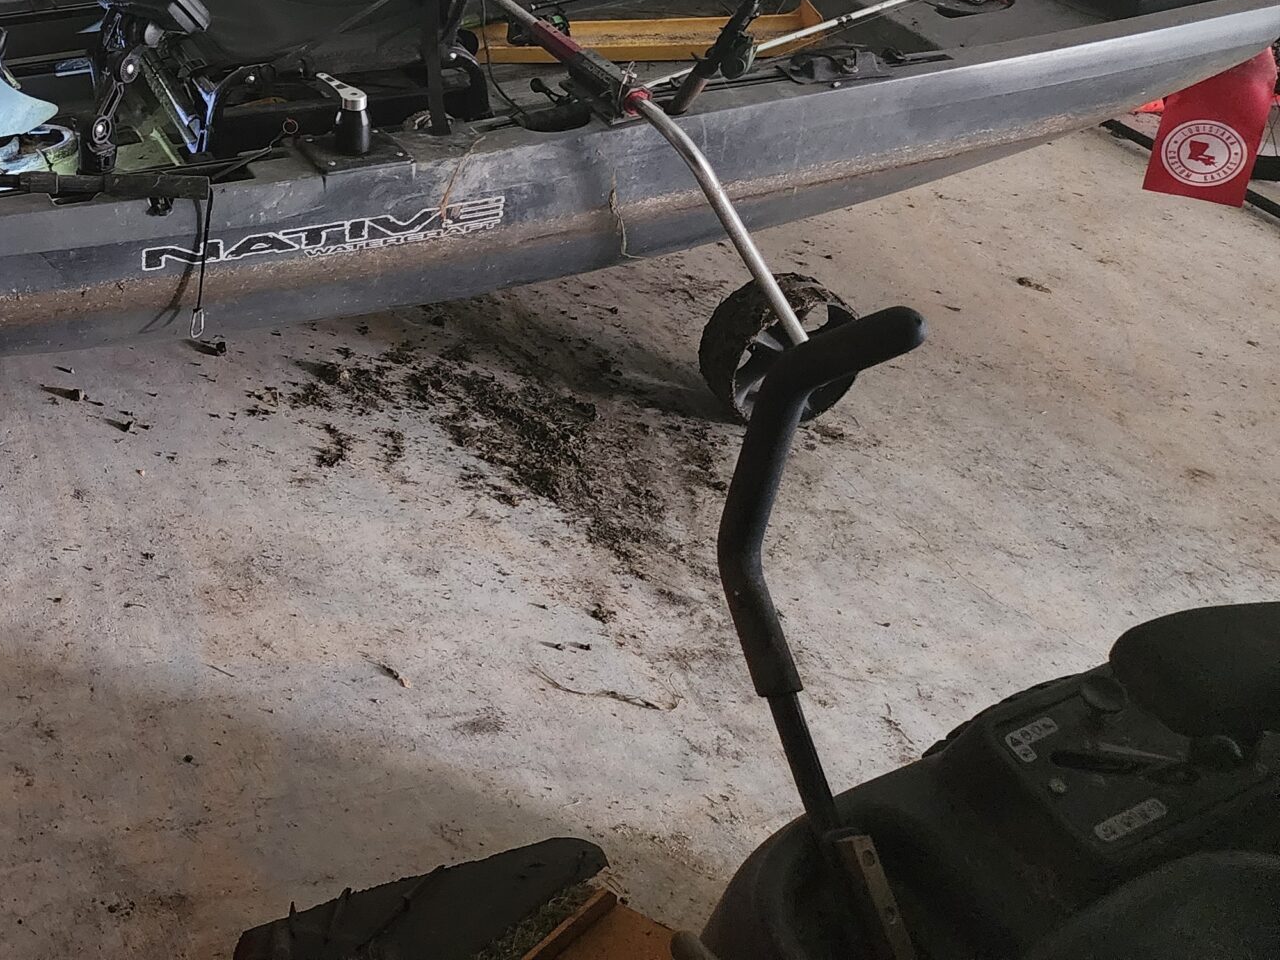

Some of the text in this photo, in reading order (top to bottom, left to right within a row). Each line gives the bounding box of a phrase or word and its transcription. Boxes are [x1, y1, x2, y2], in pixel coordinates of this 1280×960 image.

[1181, 126, 1237, 146] LOUISIANA
[1168, 150, 1237, 181] CUSTOM KAYAKS
[142, 196, 505, 271] NATIVE
[304, 219, 501, 258] WATERCRAFT
